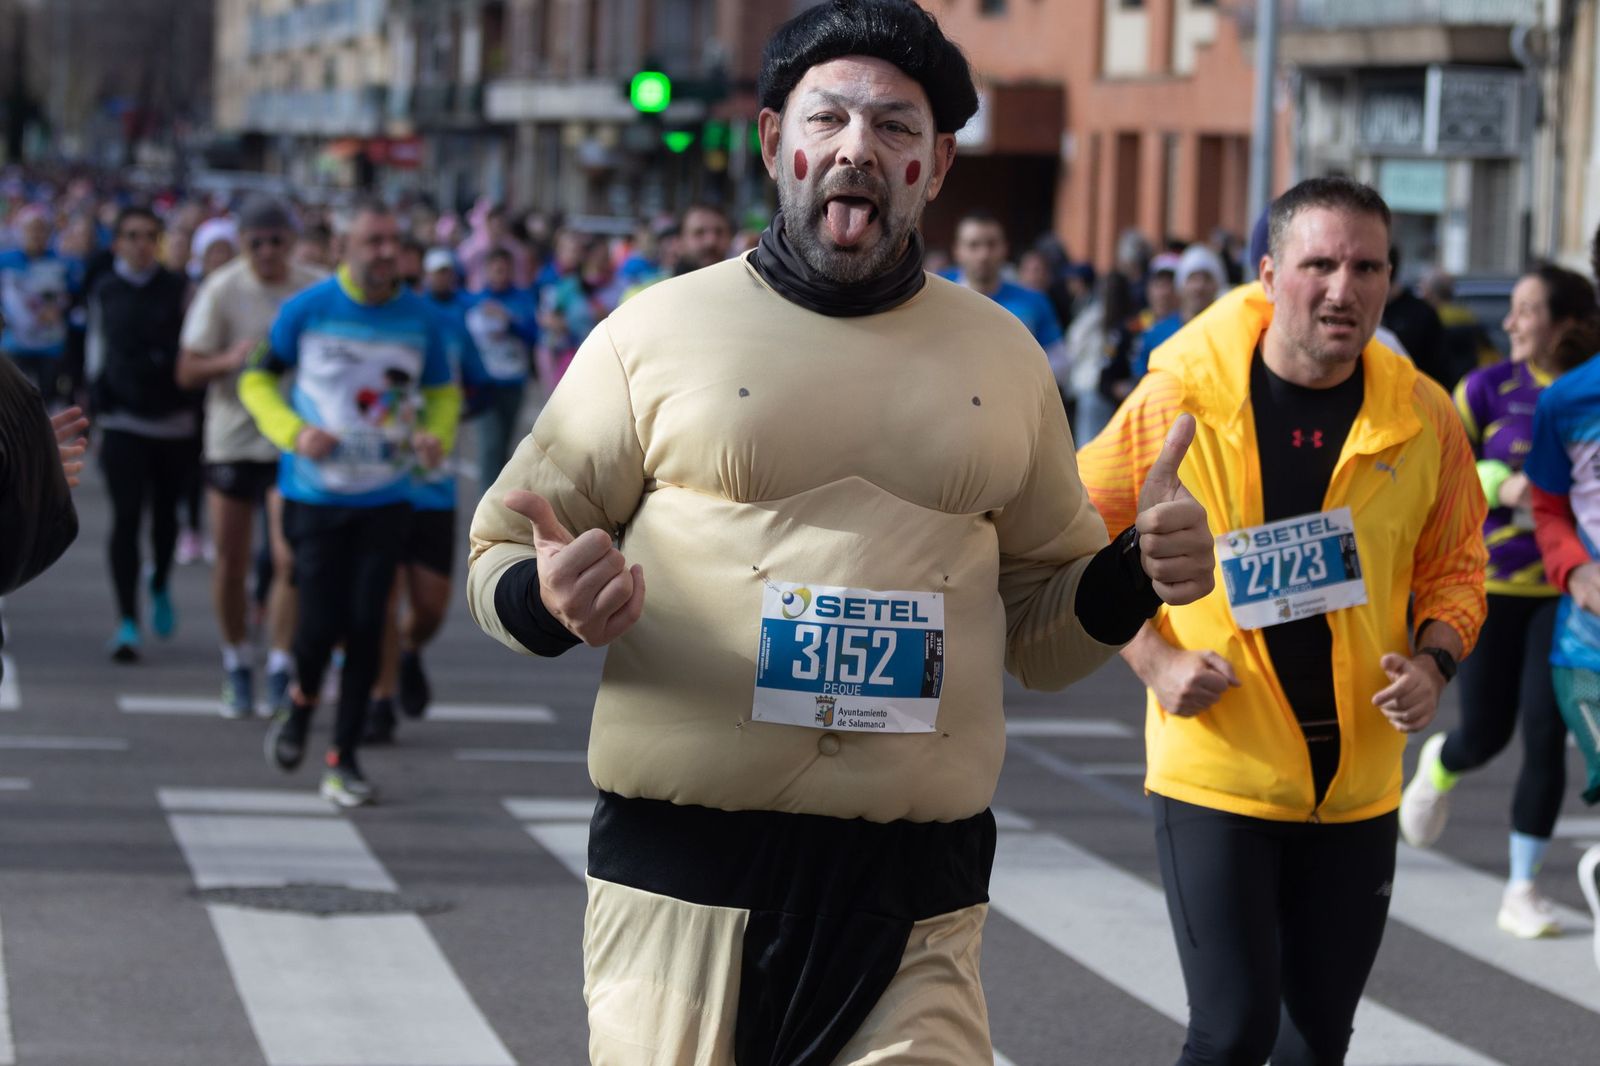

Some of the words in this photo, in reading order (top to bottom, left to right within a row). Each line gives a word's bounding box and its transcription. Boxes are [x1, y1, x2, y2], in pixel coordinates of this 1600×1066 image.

[1253, 517, 1339, 548] SETEL
[1240, 541, 1328, 596] 2723
[815, 595, 929, 623] SETEL
[791, 623, 898, 686] 3152
[823, 683, 862, 695] PEQUE
[837, 706, 888, 718] Ayuntamiento
[837, 719, 846, 727] de
[848, 720, 886, 729] Salamanca
